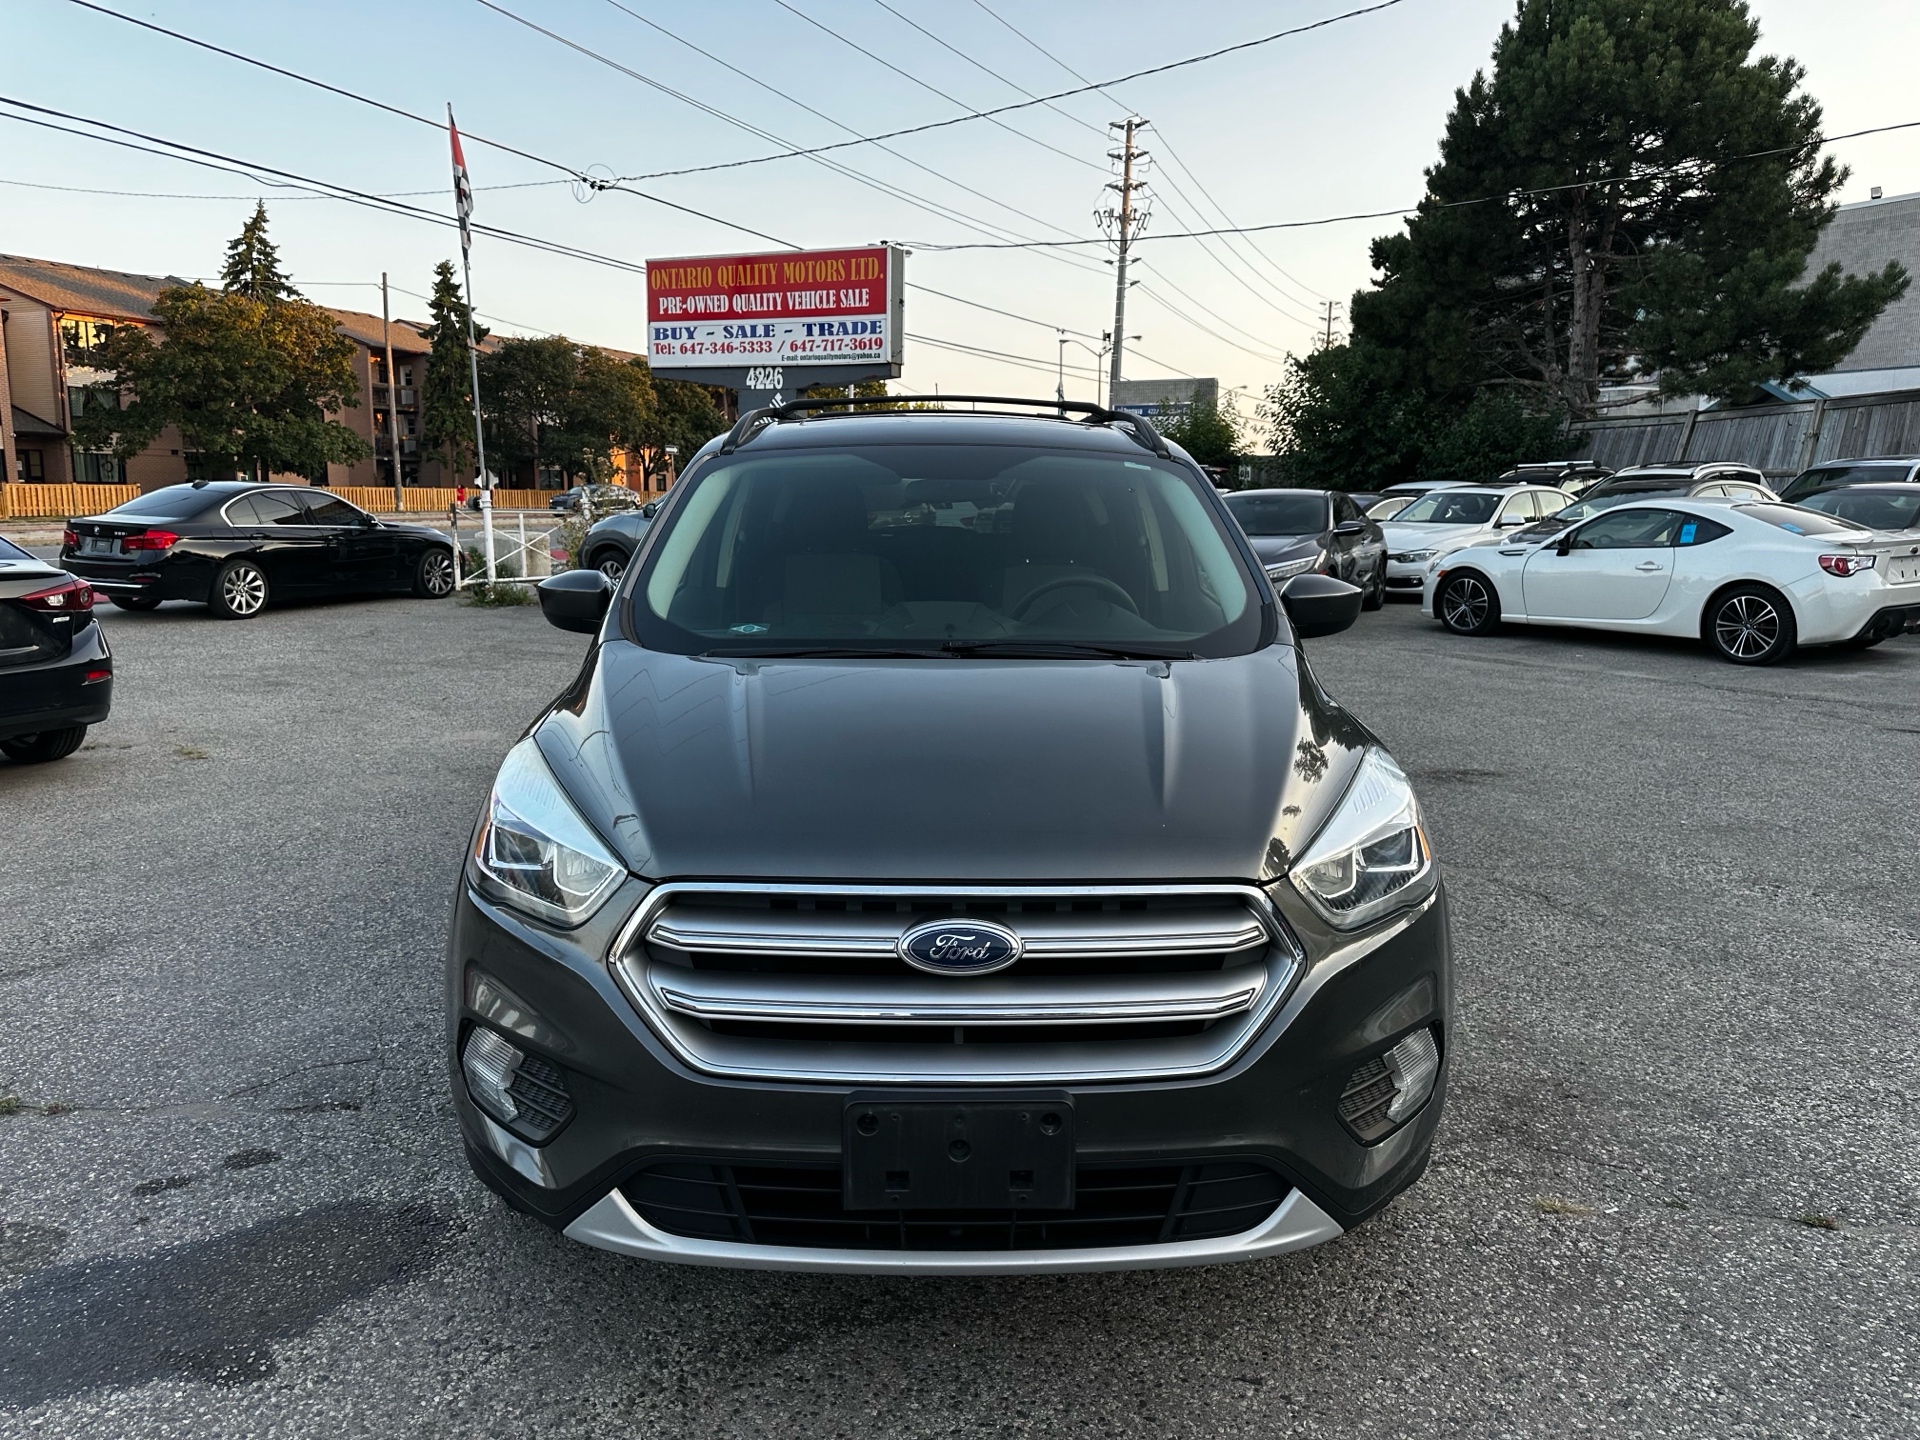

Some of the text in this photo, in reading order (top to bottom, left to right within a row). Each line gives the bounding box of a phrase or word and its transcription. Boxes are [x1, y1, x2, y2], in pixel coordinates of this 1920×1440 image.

[651, 257, 884, 290] ONTARIO QUALITY MOTORS LTD.
[659, 288, 870, 315] PRE-OWNED QUALITY VEHICLE SALE
[654, 326, 698, 341] BUY
[723, 324, 776, 339] SALE
[802, 320, 883, 337] TRADE
[654, 336, 884, 355] Tel: 647-346-5333 / 647-717-3619
[781, 352, 881, 362] E-mail: ontarioqualitymotors@yahoo.ca
[746, 367, 784, 390] 4226
[929, 934, 991, 960] Ford
